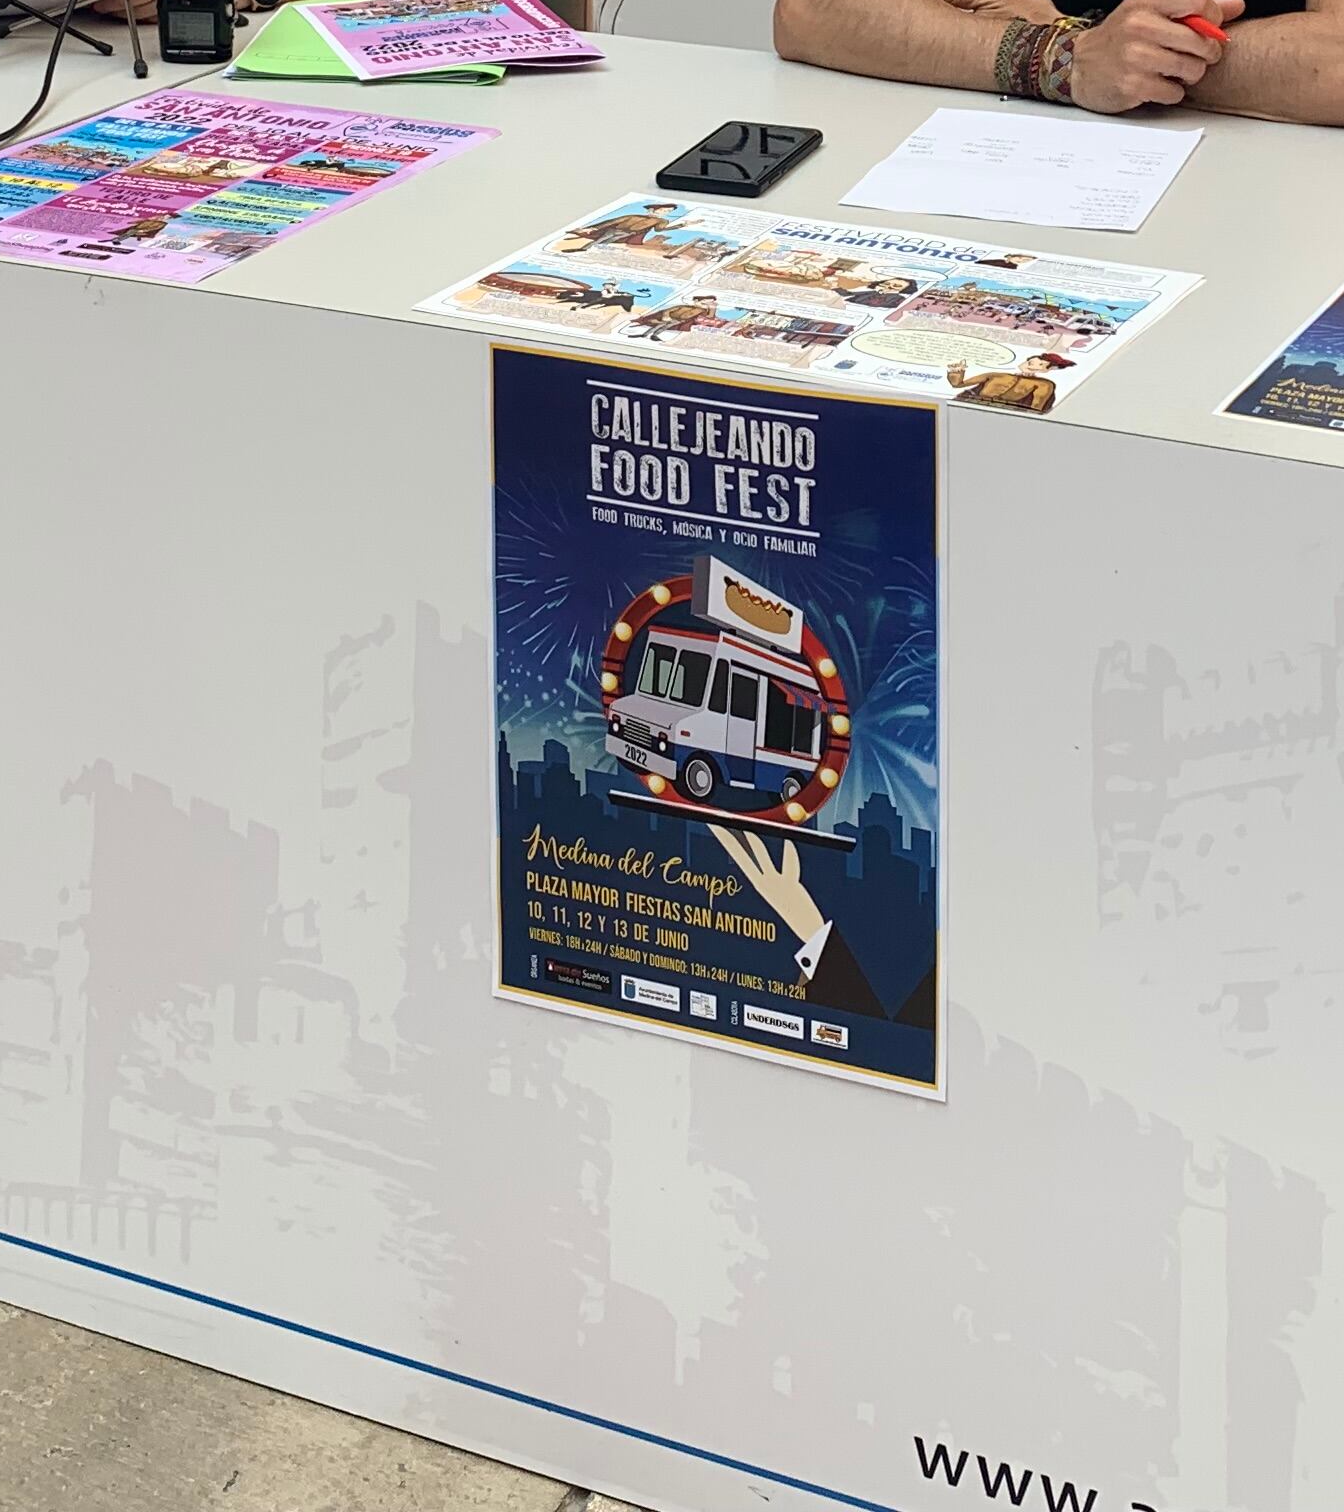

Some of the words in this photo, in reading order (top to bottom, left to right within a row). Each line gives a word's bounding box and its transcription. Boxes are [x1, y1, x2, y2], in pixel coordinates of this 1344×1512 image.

[771, 228, 832, 241] SAN
[835, 237, 978, 262] ANTONIO
[782, 222, 946, 248] FESTIVIDAD
[953, 246, 988, 254] de
[591, 394, 815, 471] CALLEJEANDO
[591, 443, 690, 505] FOOD
[715, 464, 816, 526] FEST
[592, 506, 618, 523] FOOD
[624, 512, 667, 535] TRUCKS,
[673, 520, 713, 540] MÚSICA
[719, 529, 726, 543] Y
[733, 531, 757, 548] OCIO
[764, 536, 817, 557] FAMILIAR
[624, 743, 648, 767] 2022
[523, 824, 614, 870] Medina
[617, 848, 656, 879] del
[660, 857, 742, 909] Campo
[527, 871, 568, 898] PLAZA
[571, 880, 618, 908] MAYOR
[626, 891, 680, 923] FIESTAS
[684, 905, 712, 928] SAN
[715, 909, 776, 942] ANTONIO
[528, 901, 545, 921] 10,
[552, 905, 570, 928] 11,
[576, 910, 592, 930] 12
[597, 915, 607, 932] Y
[613, 919, 628, 938] 13
[634, 923, 649, 943] DE
[656, 929, 689, 951] JUNIO
